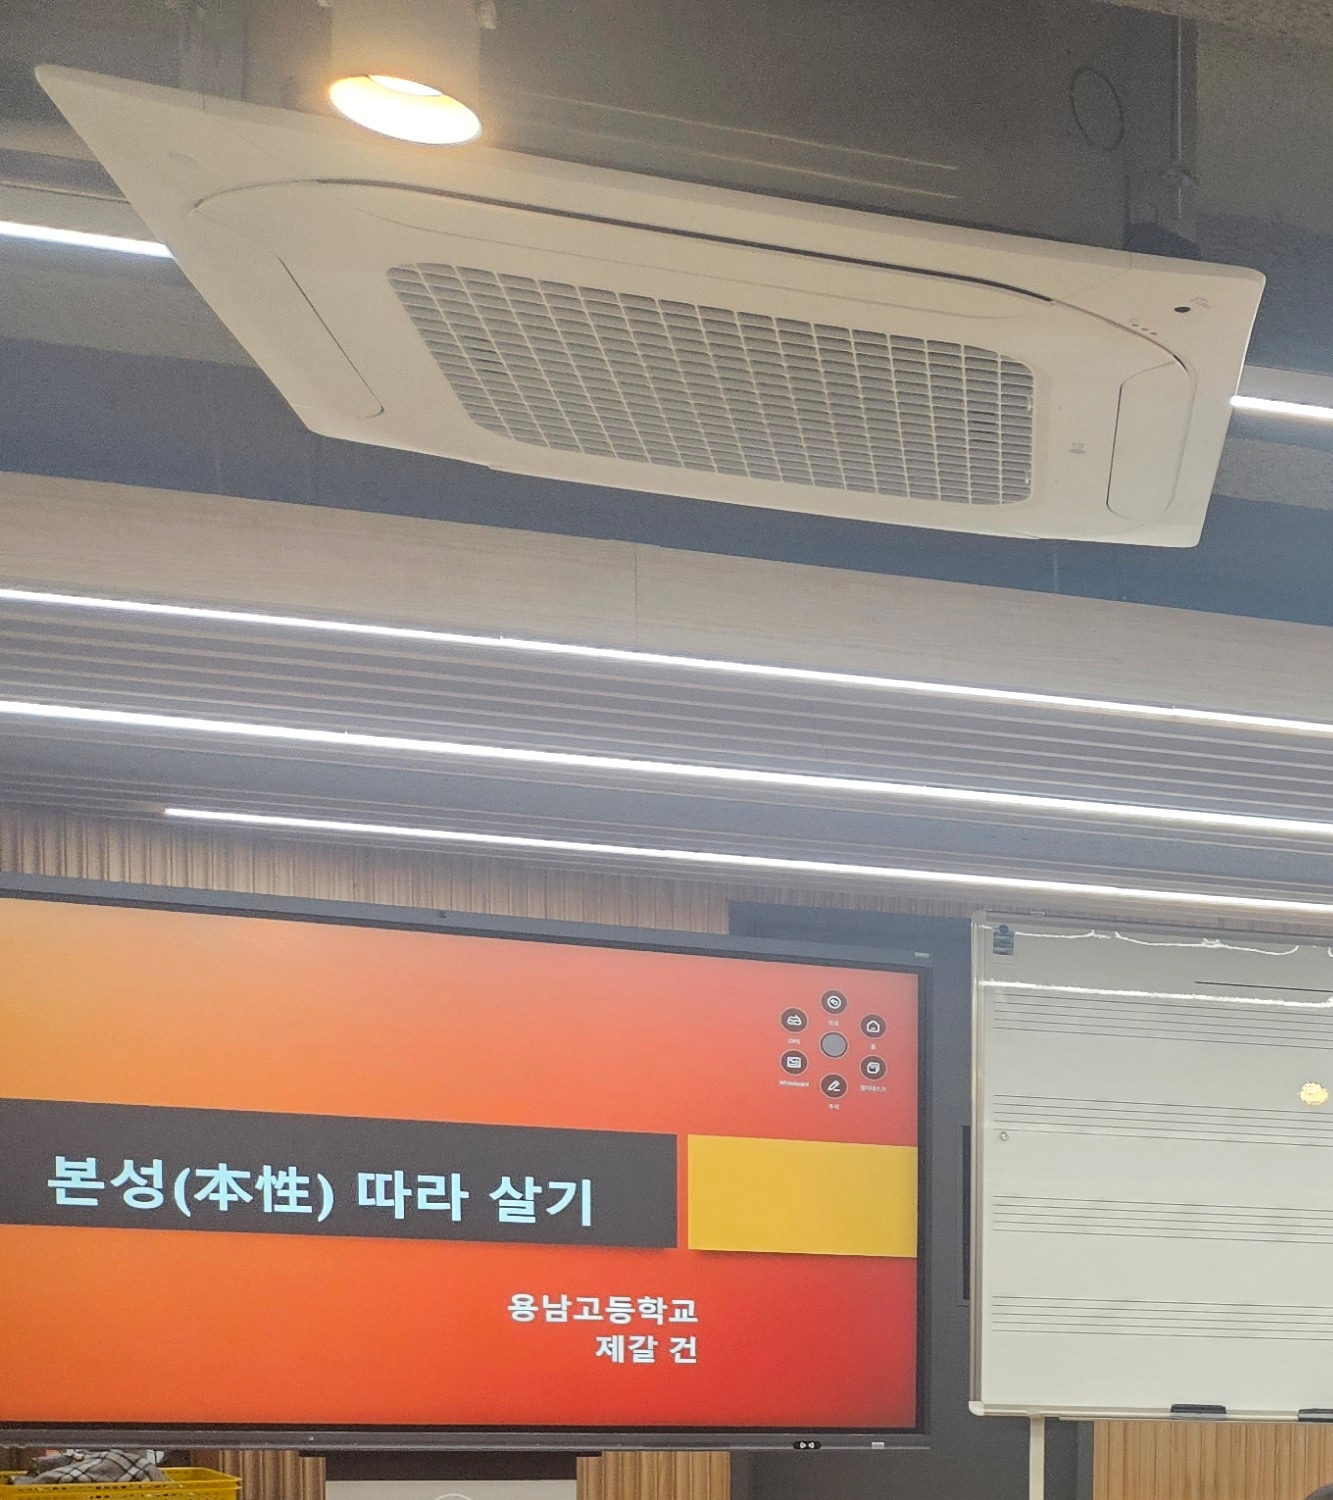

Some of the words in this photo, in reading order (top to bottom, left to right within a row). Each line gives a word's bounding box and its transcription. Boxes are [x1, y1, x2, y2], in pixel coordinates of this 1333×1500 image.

[47, 1155, 334, 1222] 본성(本性)
[358, 1169, 469, 1221] 따라
[489, 1175, 593, 1227] 살기
[507, 1293, 699, 1326] 용남고등학교
[595, 1334, 659, 1364] 제갈
[669, 1335, 698, 1365] 건
